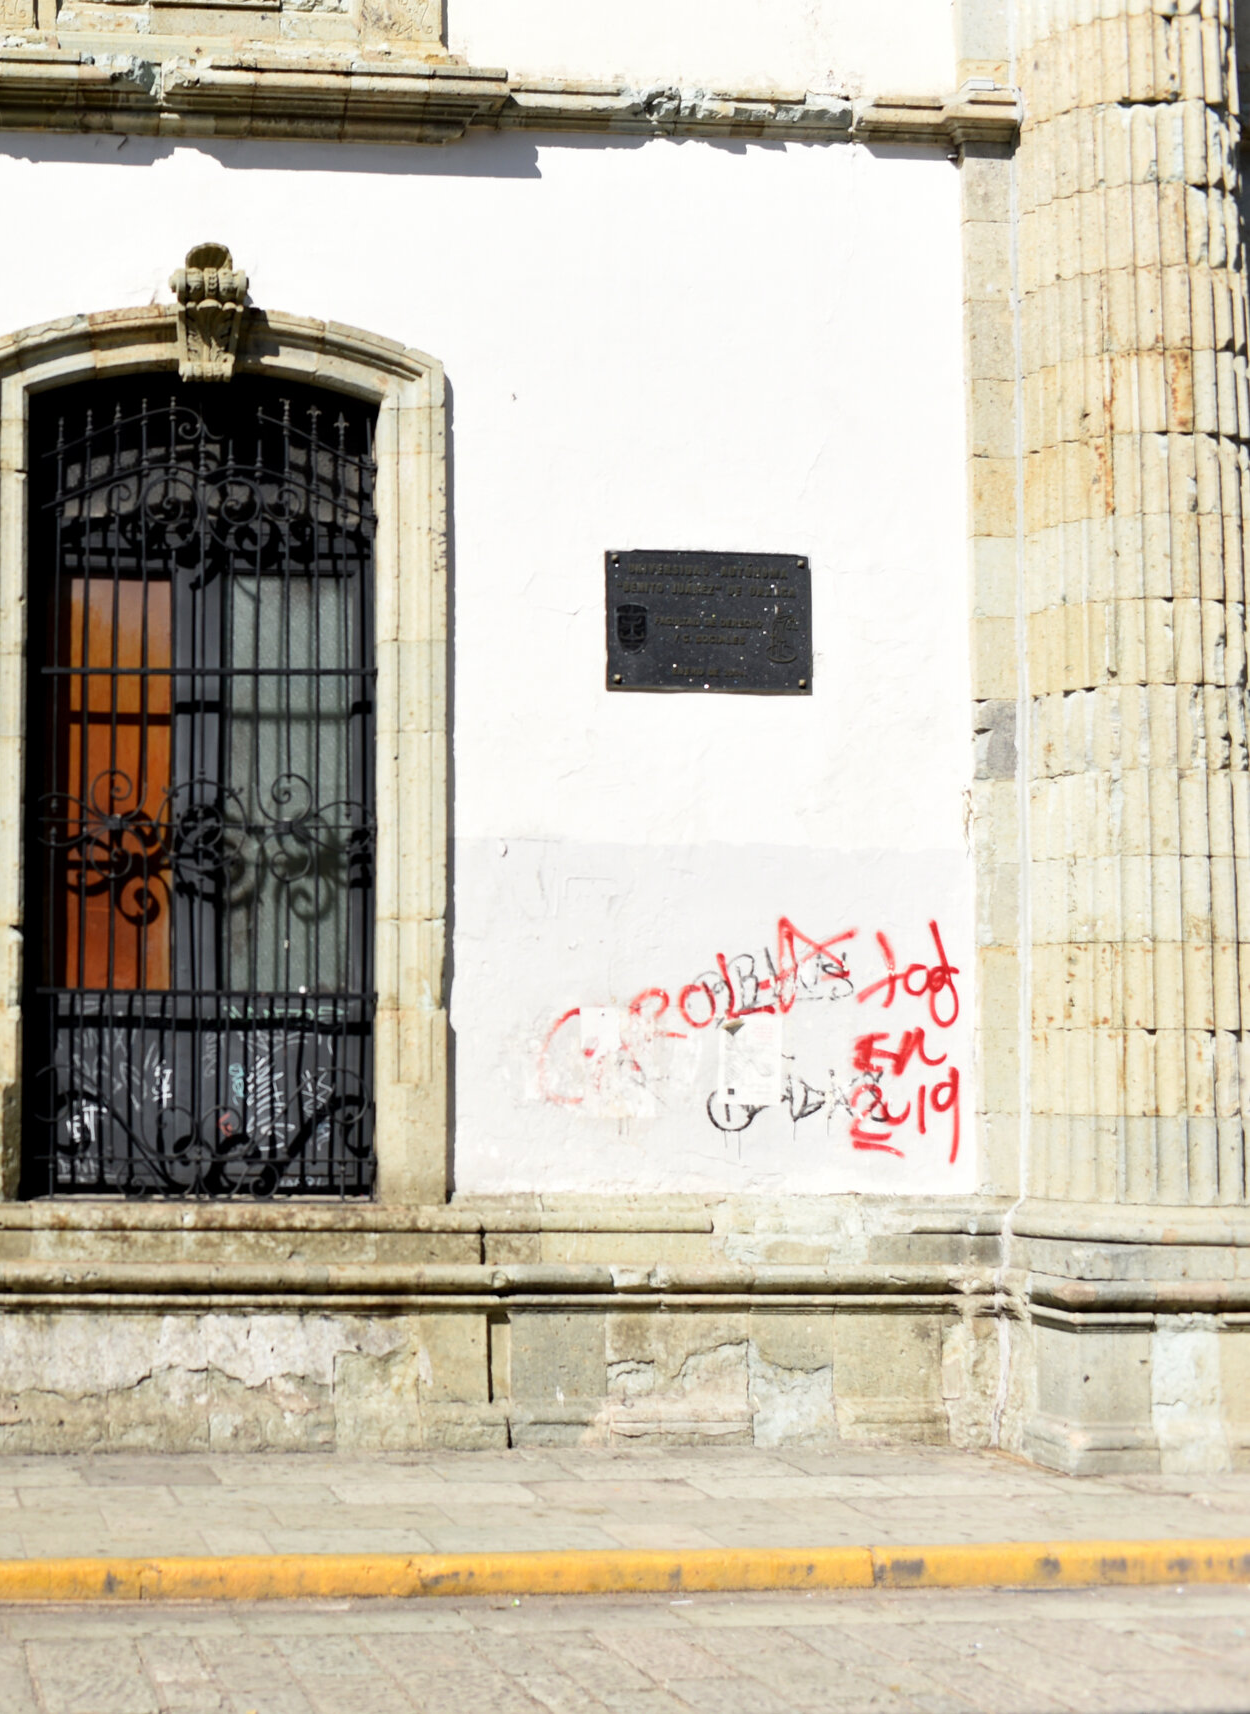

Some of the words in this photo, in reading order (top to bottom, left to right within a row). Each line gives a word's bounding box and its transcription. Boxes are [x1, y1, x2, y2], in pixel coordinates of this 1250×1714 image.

[628, 562, 710, 578] UNIVERSIDAD
[727, 584, 742, 597] DE
[653, 616, 700, 628] FACULTAD
[703, 617, 717, 628] DE
[719, 618, 764, 629] DERECHO
[695, 634, 747, 646] SOCIALES
[708, 668, 720, 677] DE
